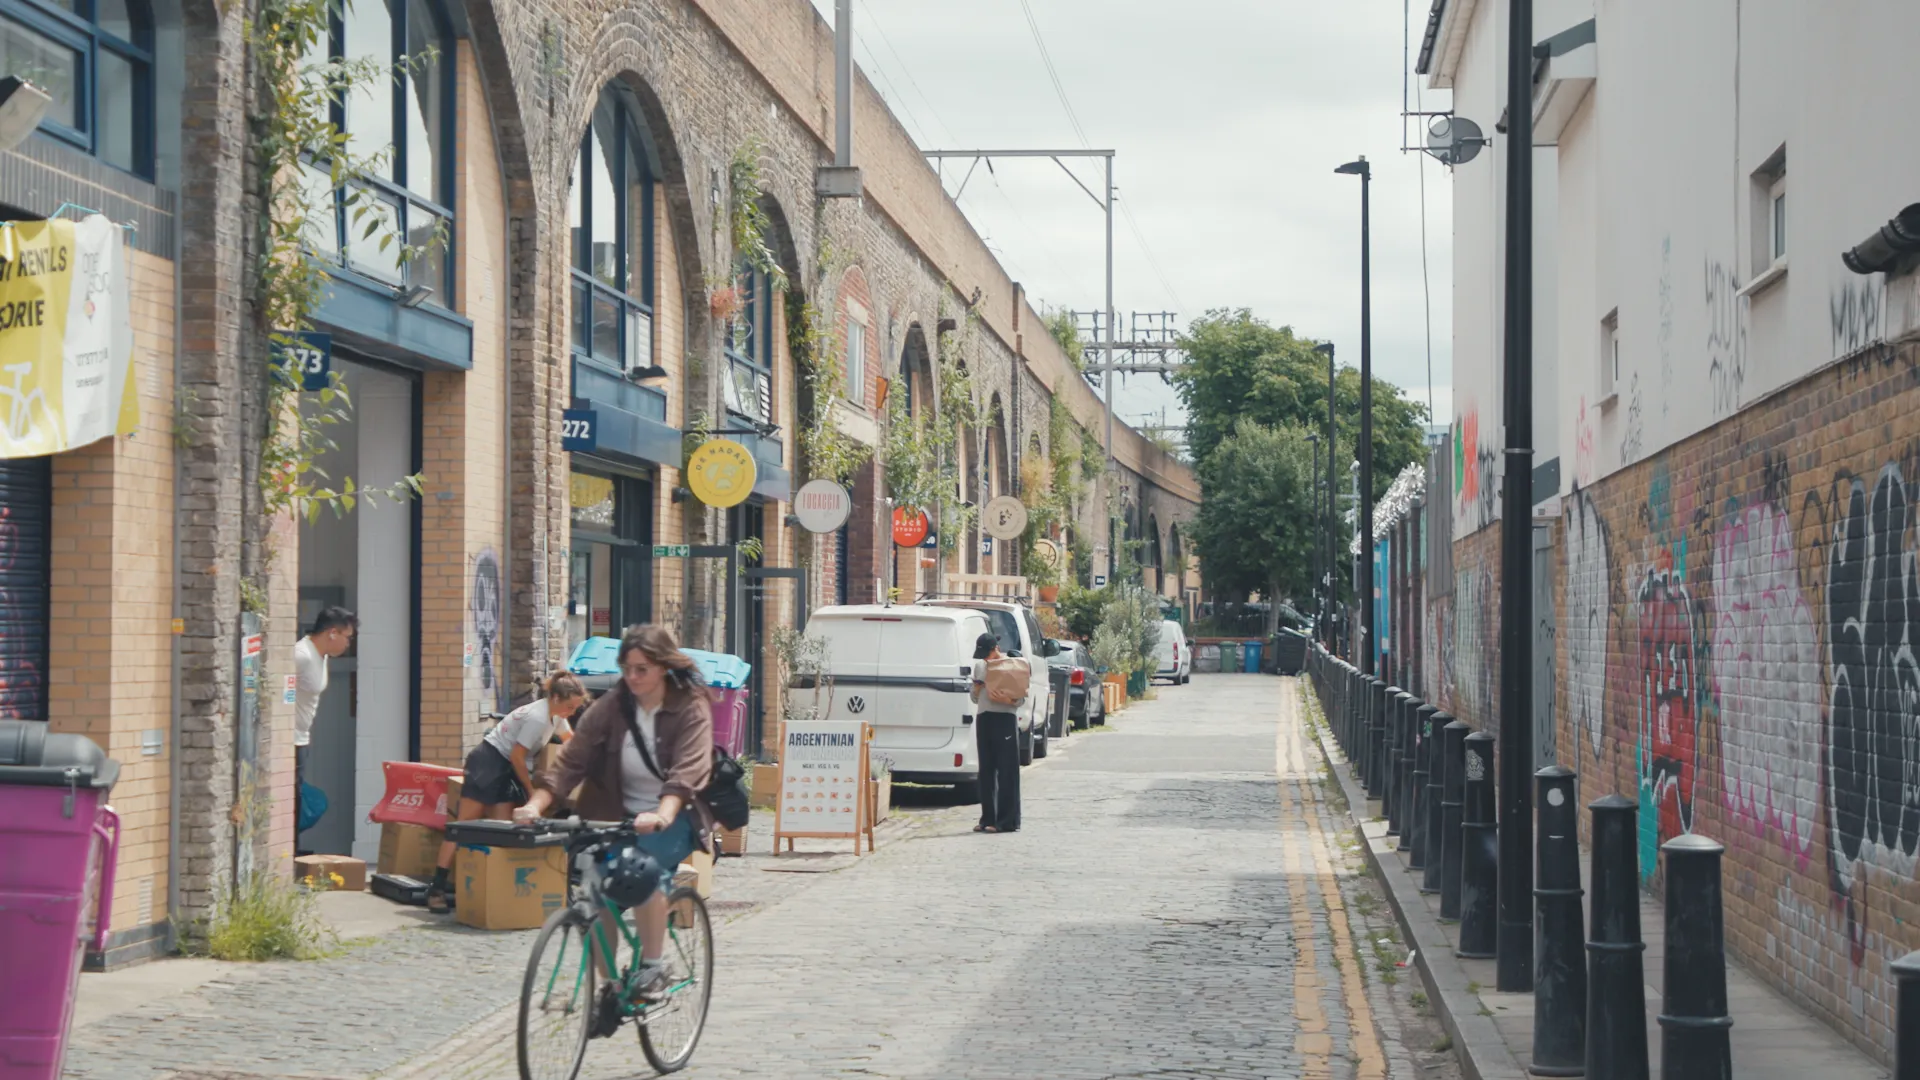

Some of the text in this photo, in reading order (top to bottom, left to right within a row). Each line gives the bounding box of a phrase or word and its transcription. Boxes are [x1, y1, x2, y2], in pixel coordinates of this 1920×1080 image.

[282, 347, 323, 374] 273
[562, 419, 590, 439] 272
[982, 541, 991, 553] 67
[788, 732, 855, 747] ARGENTINIAN
[391, 794, 424, 807] FAST
